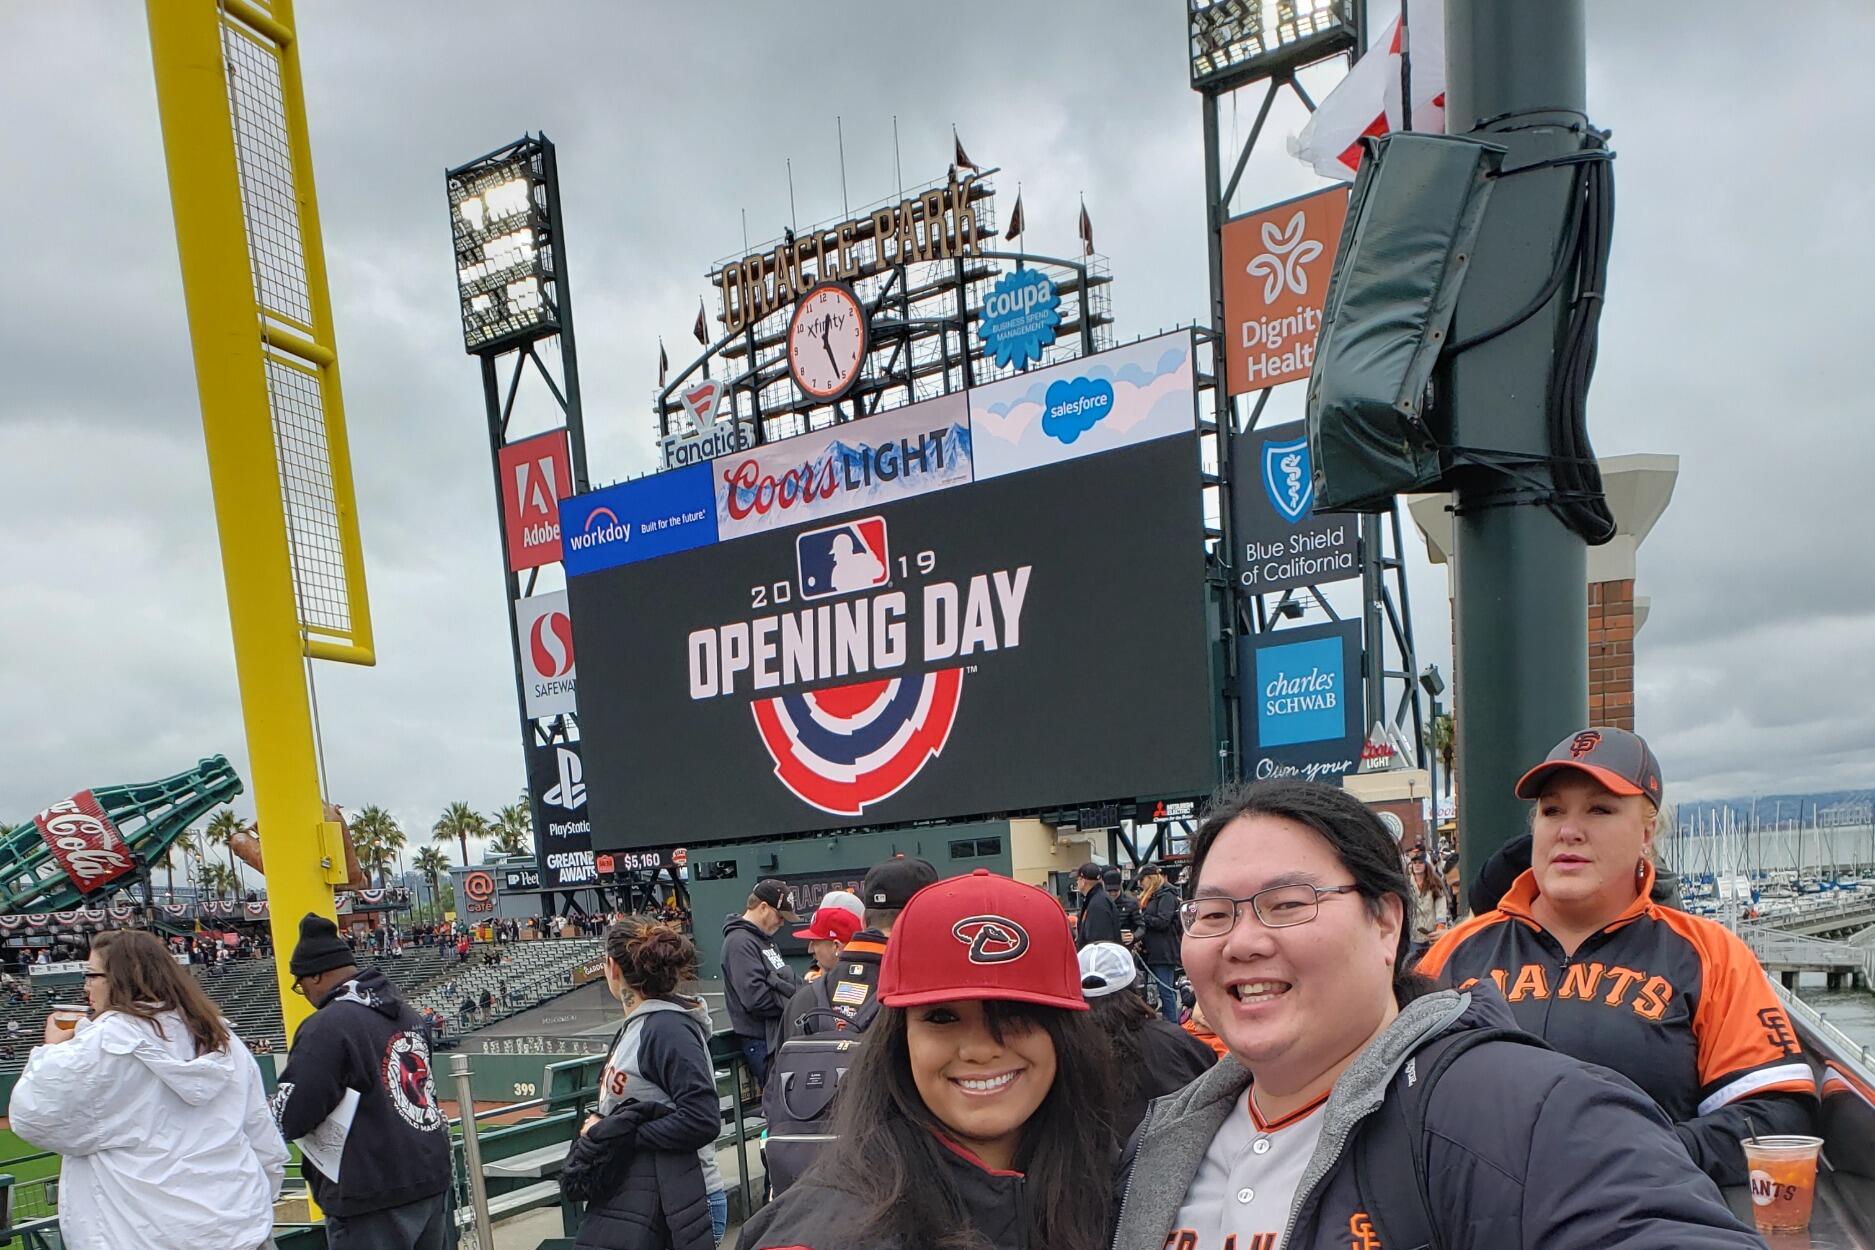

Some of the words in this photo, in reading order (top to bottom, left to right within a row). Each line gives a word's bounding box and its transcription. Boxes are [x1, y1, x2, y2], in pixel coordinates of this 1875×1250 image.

[721, 218, 859, 334] ORACLE
[871, 175, 981, 269] PARK
[986, 280, 1051, 319] coupa
[992, 315, 1025, 333] BUSINESS
[1024, 309, 1049, 324] SPEND
[996, 321, 1046, 341] MANAGEMENT
[1247, 338, 1317, 382] Healt
[1051, 393, 1108, 418] salesforce
[664, 426, 749, 465] Fanatics
[723, 456, 841, 521] Coors
[843, 427, 949, 491] LIGHT
[523, 521, 560, 548] Adobe
[570, 523, 631, 551] workday
[641, 523, 658, 534] Built
[657, 519, 668, 530] for
[668, 515, 681, 527] the
[1246, 541, 1284, 562] Blue
[1289, 525, 1344, 553] Shield
[1241, 565, 1260, 586] of
[1263, 550, 1352, 581] California
[687, 590, 908, 700] OPENING
[923, 565, 1033, 662] DAY
[1266, 667, 1336, 697] charles
[1266, 692, 1337, 716] SCHWAB
[1360, 738, 1398, 759] Coors
[1256, 757, 1299, 780] Own
[1299, 759, 1353, 783] your
[1366, 756, 1390, 769] LIGHT
[549, 821, 591, 839] PlayStatio
[624, 853, 660, 871] $5,160
[1458, 961, 1674, 1021] IANTS
[513, 1082, 536, 1097] 399
